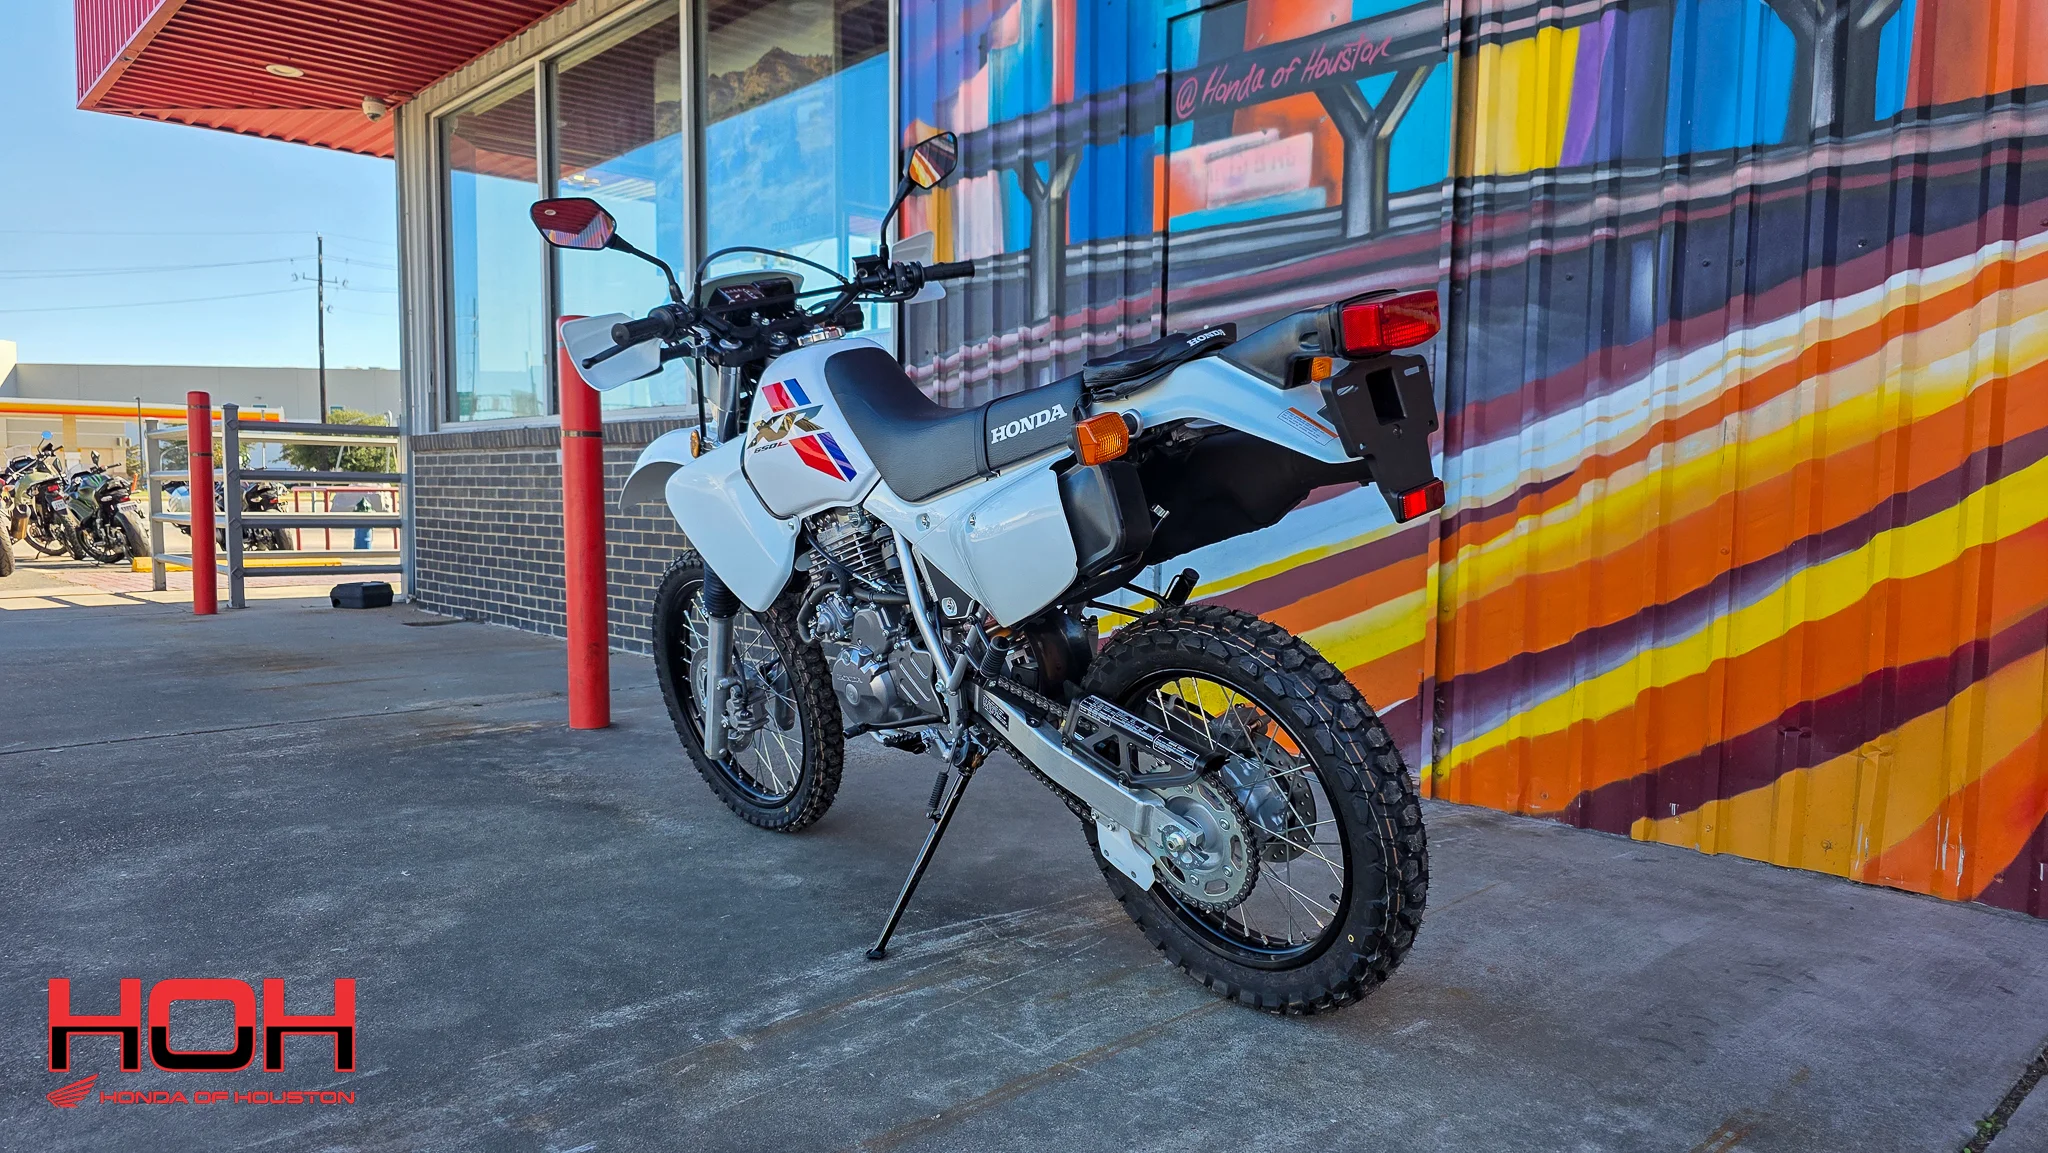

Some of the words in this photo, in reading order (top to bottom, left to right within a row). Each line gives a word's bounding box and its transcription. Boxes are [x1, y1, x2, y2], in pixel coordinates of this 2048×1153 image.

[1176, 77, 1199, 119] @
[1201, 62, 1264, 105] Honda
[1271, 58, 1300, 89] of
[1301, 33, 1393, 83] Houston
[1186, 329, 1226, 347] HONDA
[991, 403, 1067, 444] HONDA
[754, 441, 788, 453] 650L
